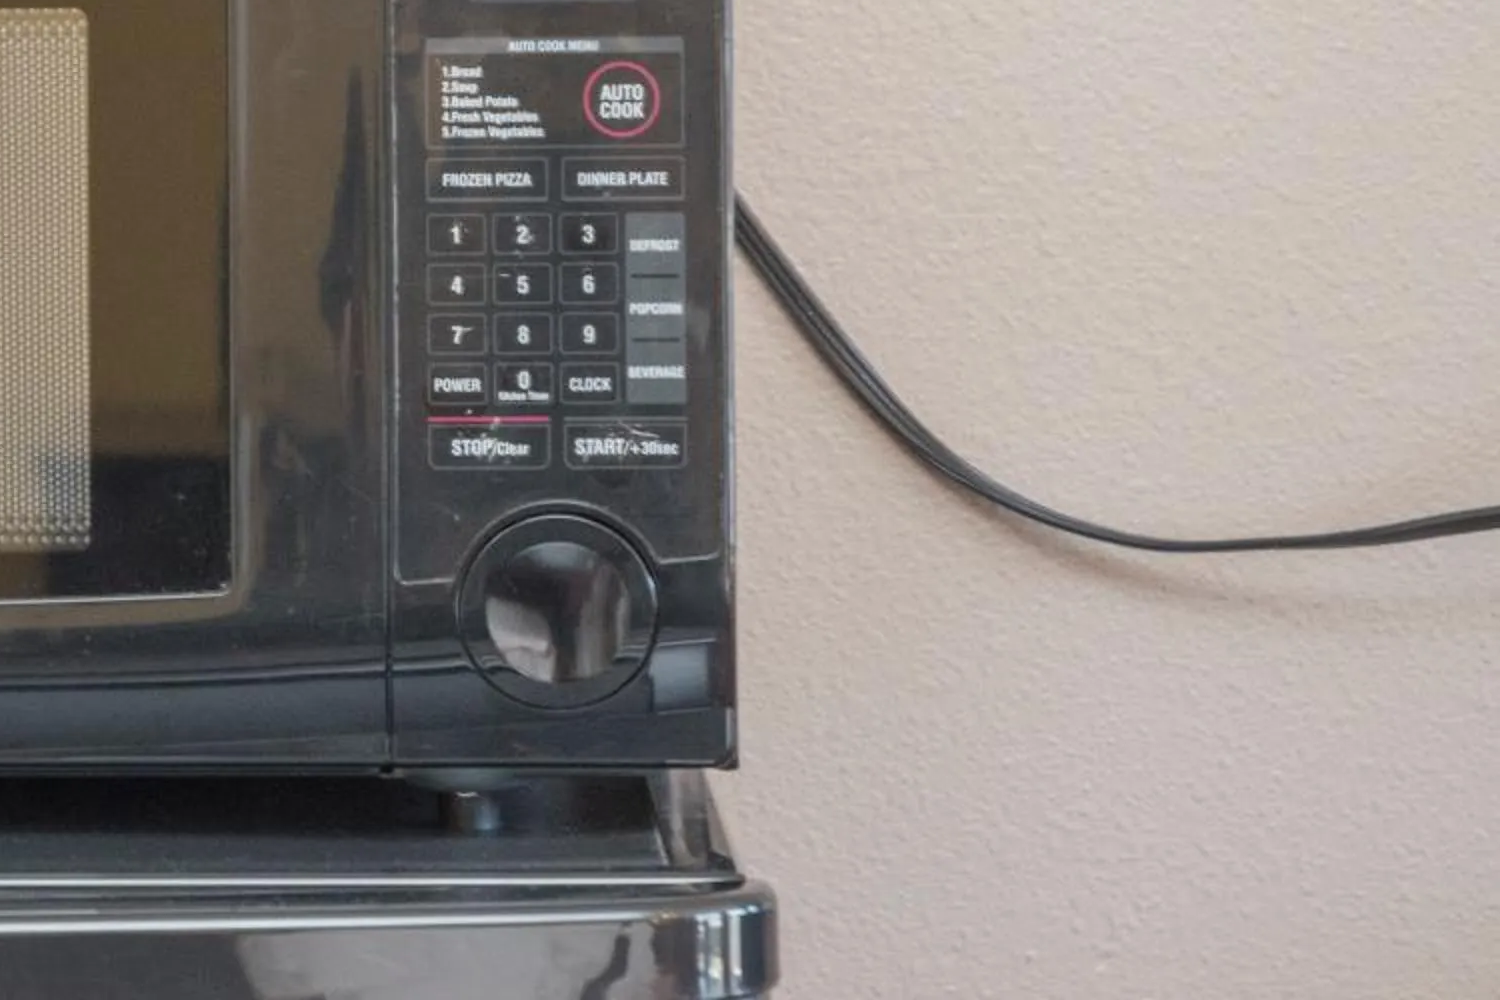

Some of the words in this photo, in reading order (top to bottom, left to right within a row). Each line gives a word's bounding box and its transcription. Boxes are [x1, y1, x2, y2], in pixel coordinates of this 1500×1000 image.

[508, 40, 536, 52] AUTO
[601, 84, 644, 101] AUTO
[483, 111, 539, 125] Vegetables
[600, 102, 644, 119] COOK
[488, 126, 546, 139] Vegetables
[442, 173, 493, 187] FROZEN
[495, 173, 532, 187] PIZZA
[577, 172, 626, 186] DINNER
[628, 172, 668, 185] PLATE
[451, 225, 461, 244] 1
[516, 225, 530, 244] 2
[581, 225, 595, 244] 3
[629, 239, 679, 251] DEFROST
[451, 276, 463, 294] 4
[517, 276, 530, 294] 5
[581, 275, 595, 294] 6
[629, 303, 682, 315] POPCORN
[451, 326, 463, 344] 7
[516, 325, 530, 344] 8
[582, 325, 596, 344] 9
[517, 370, 531, 389] 0
[628, 366, 685, 379] BEVERAGE
[434, 377, 481, 393] POWER
[569, 377, 611, 392] CLOCK
[451, 439, 530, 456] STOP/Clear
